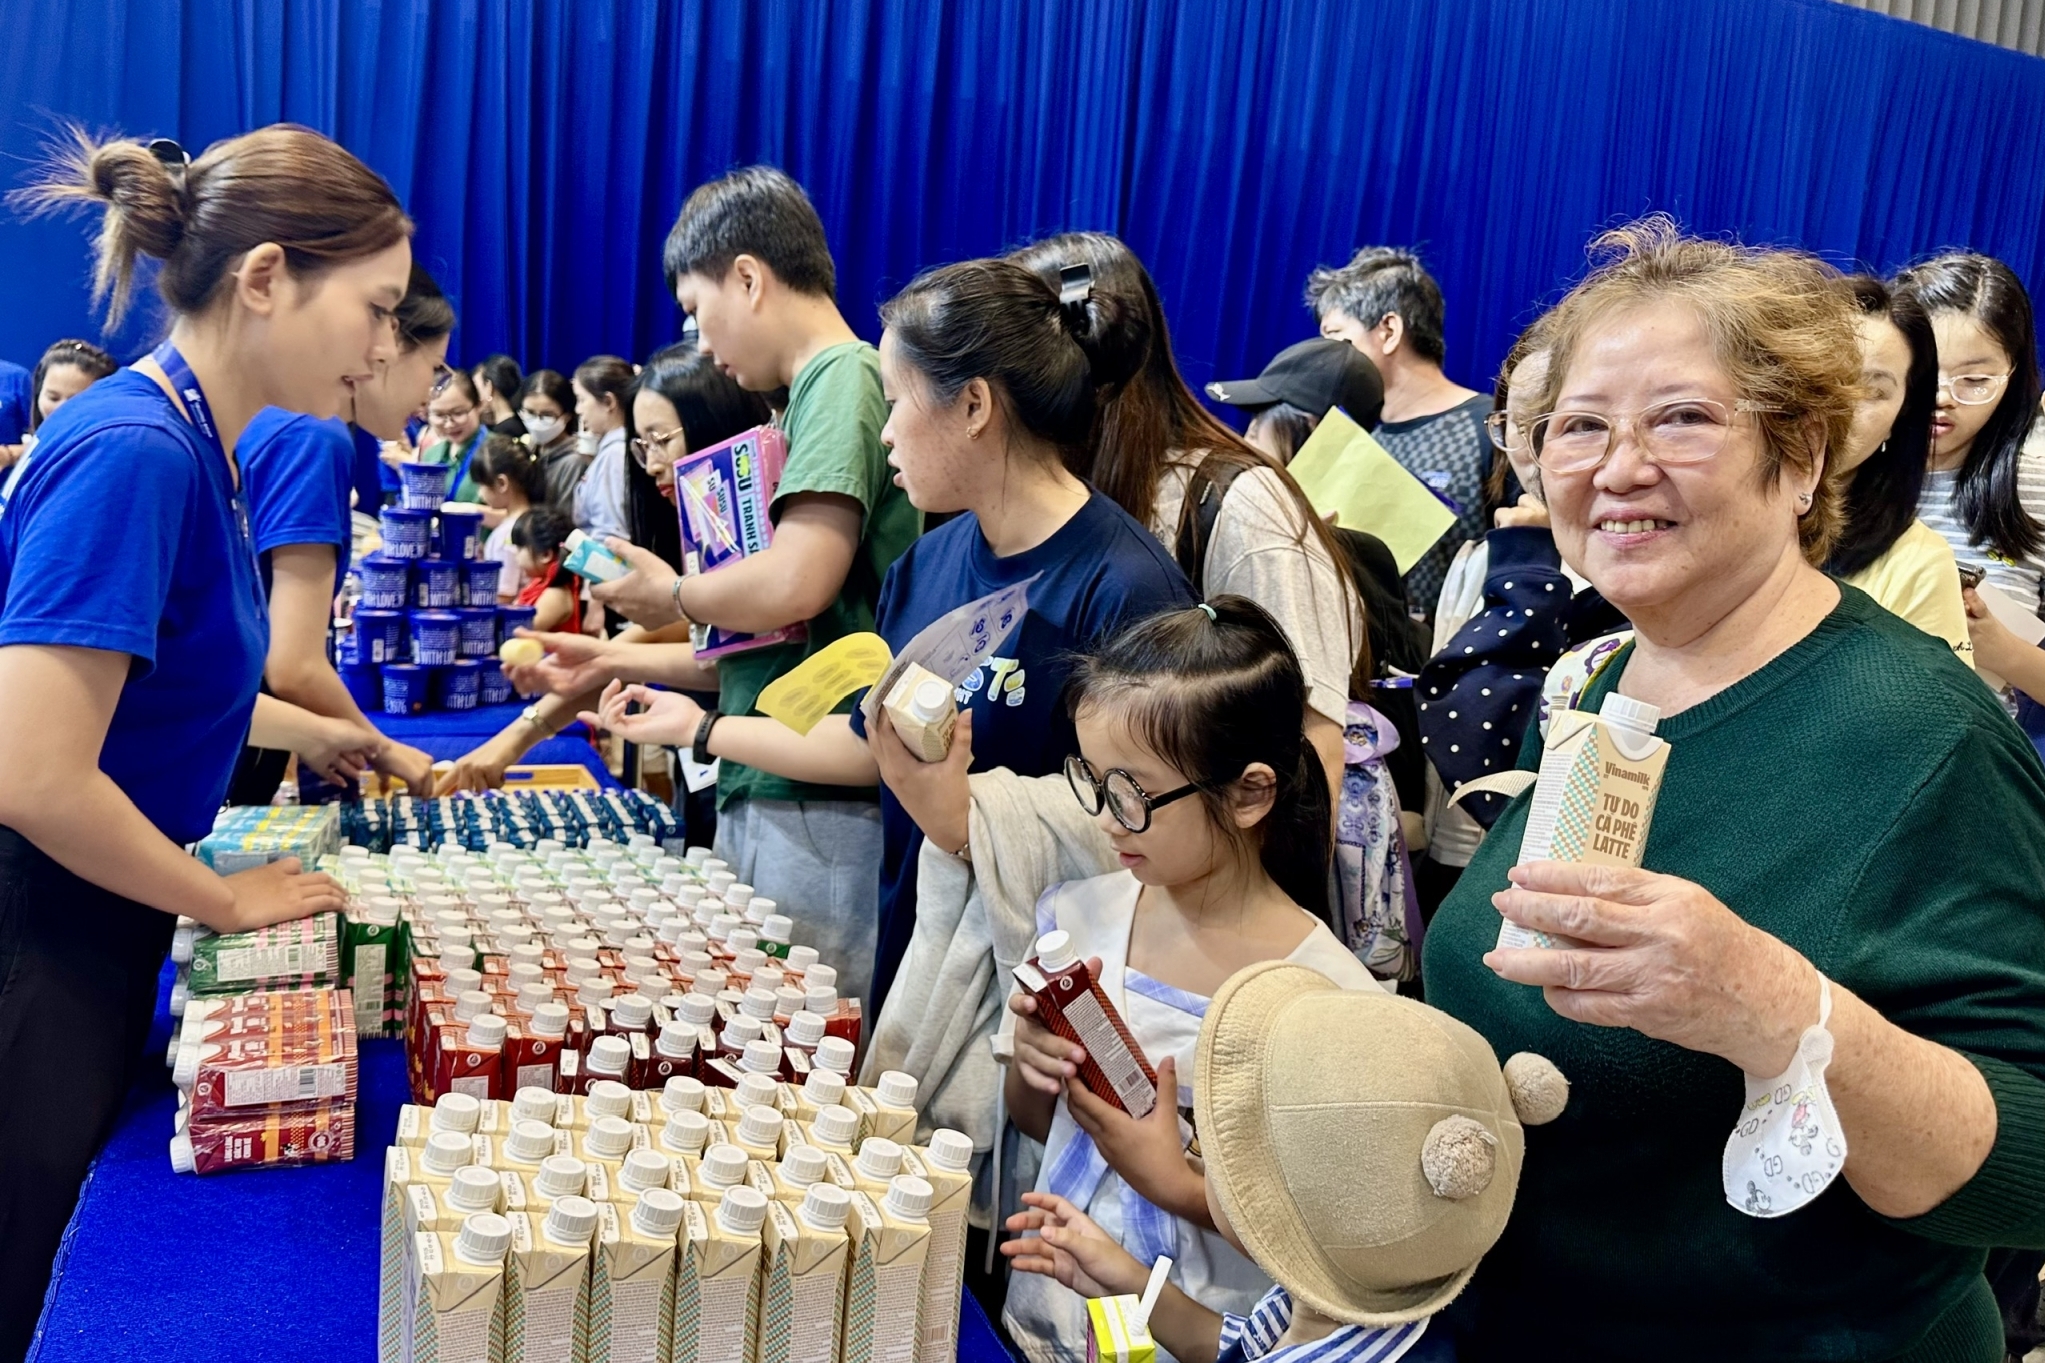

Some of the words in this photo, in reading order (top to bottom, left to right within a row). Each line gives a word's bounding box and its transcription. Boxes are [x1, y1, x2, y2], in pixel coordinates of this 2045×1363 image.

[742, 497, 757, 541] TRANH
[1605, 761, 1650, 786] Vinamilk
[1603, 793, 1621, 815] TỰ
[1621, 799, 1639, 819] DO
[1595, 813, 1612, 834] CÀ
[1612, 818, 1638, 841] PHÊ
[1592, 833, 1631, 859] LATTE
